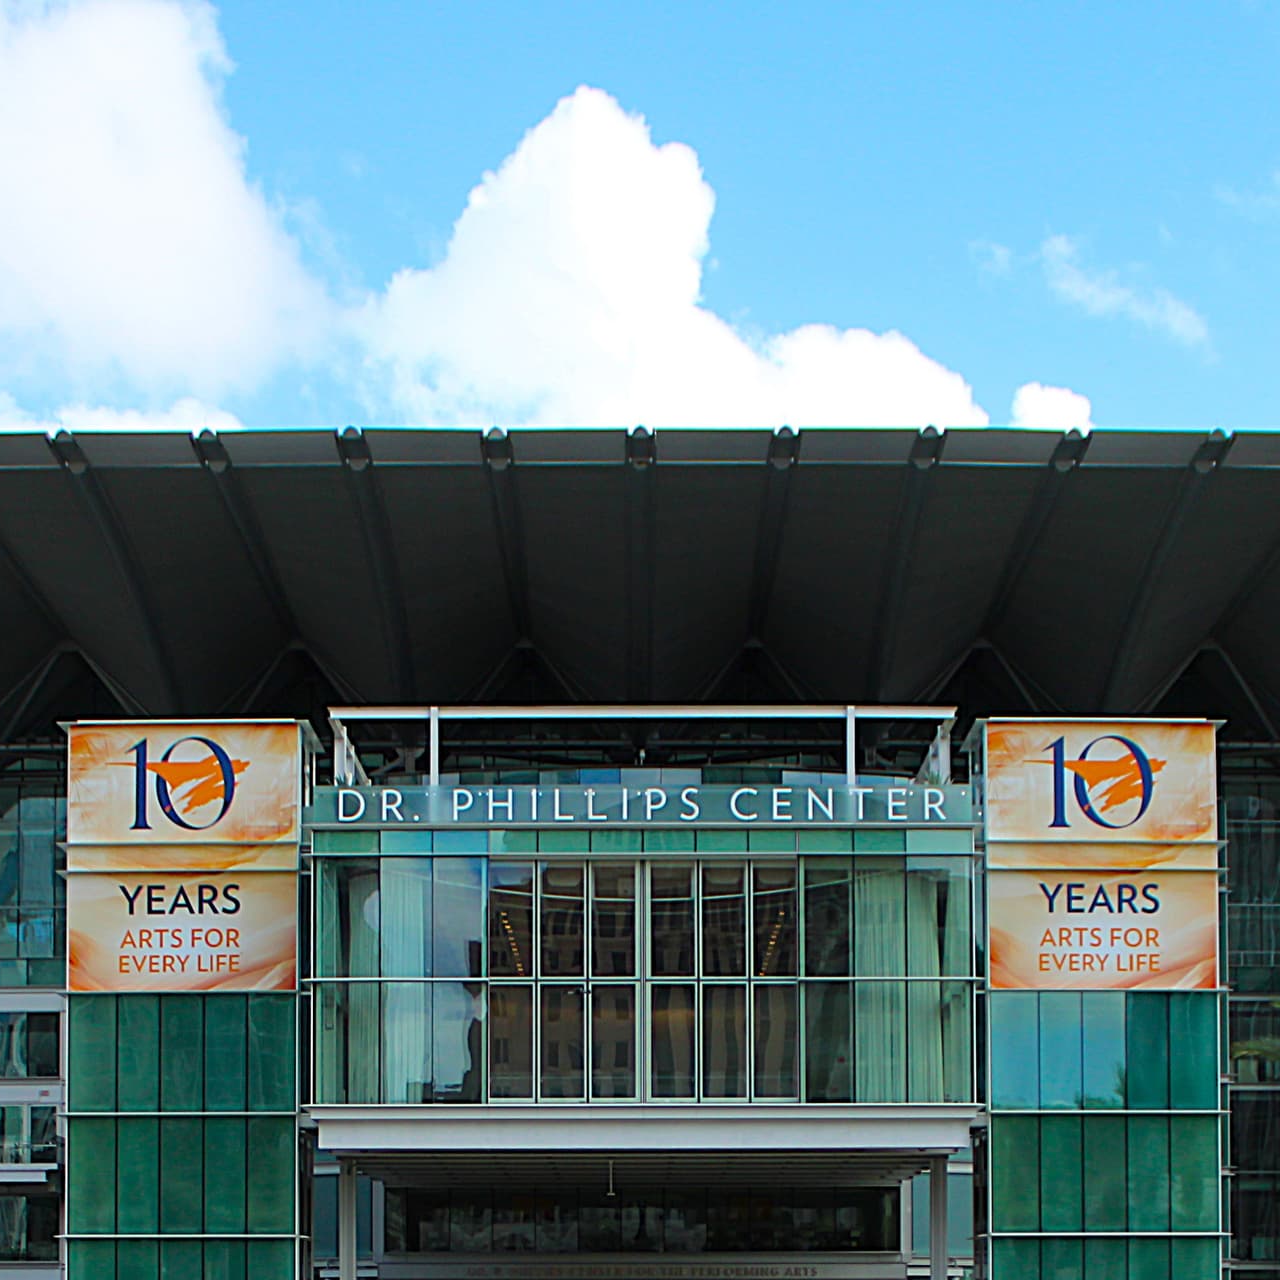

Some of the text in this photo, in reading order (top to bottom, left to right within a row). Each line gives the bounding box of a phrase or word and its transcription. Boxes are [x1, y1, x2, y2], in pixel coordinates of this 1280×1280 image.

[125, 736, 236, 830] 10
[1042, 735, 1153, 829] 10
[338, 787, 947, 822] DR. PHILLIPS CENTER
[119, 884, 241, 915] YEARS
[1039, 883, 1160, 914] YEARS
[120, 928, 241, 949] ARTS FOR
[1040, 927, 1160, 947] ARTS FOR
[119, 954, 241, 973] EVERY LIFE
[1039, 953, 1161, 972] EVERY LIFE
[784, 1267, 818, 1278] ARTS
